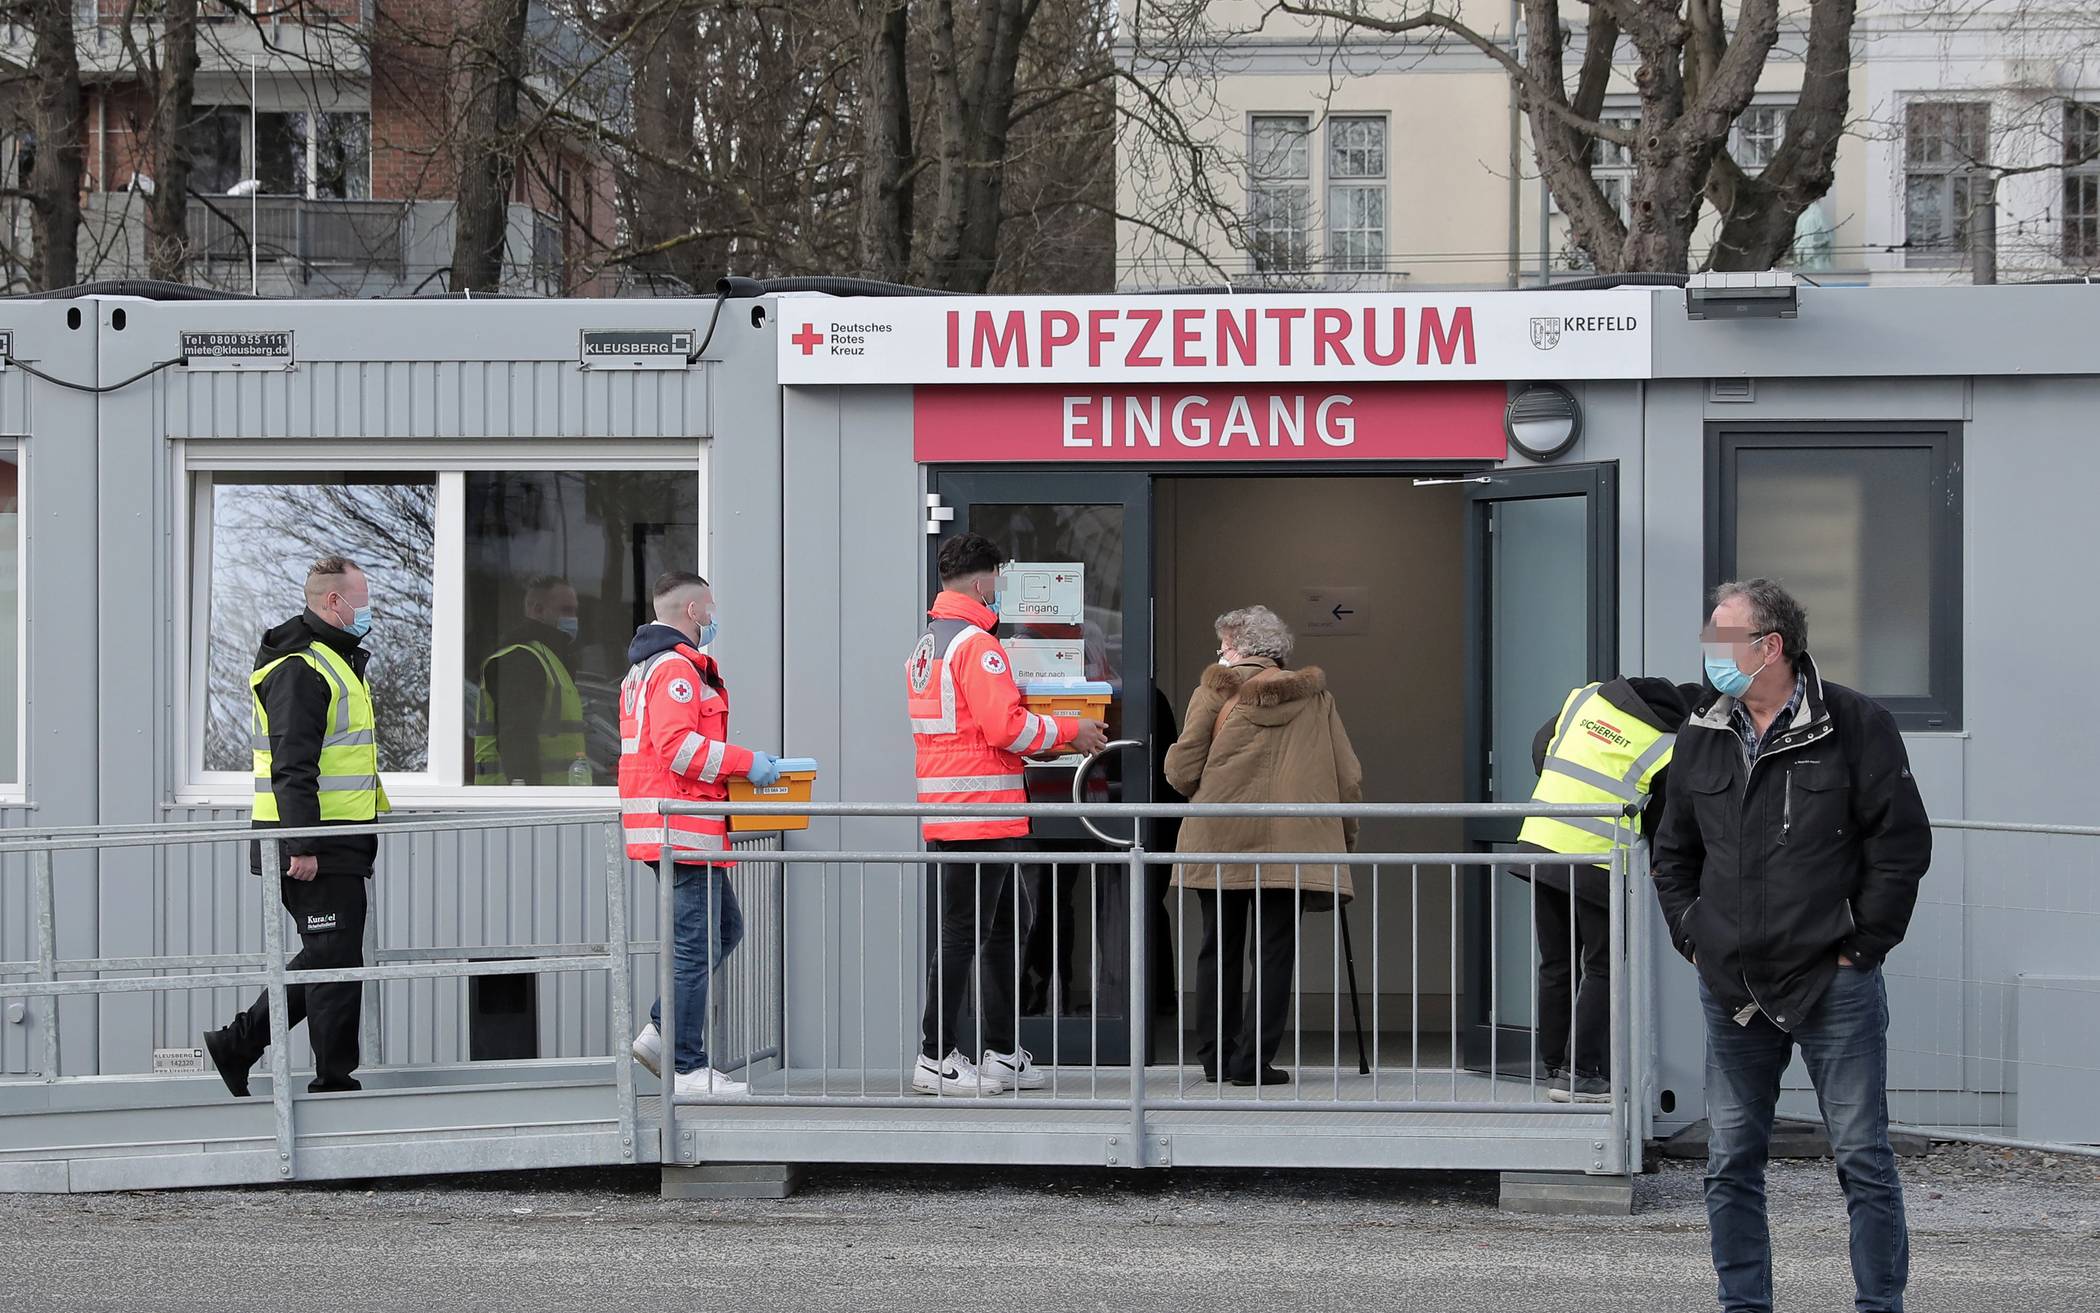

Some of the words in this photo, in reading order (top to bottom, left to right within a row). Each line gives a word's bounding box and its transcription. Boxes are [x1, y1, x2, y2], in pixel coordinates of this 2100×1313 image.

[830, 322, 893, 333] Deutsches
[1563, 316, 1638, 332] KREFELD
[184, 335, 206, 345] Tel.
[210, 335, 237, 345] 0800
[240, 335, 261, 345] 955
[264, 335, 289, 345] 1111
[830, 334, 865, 344] Rotes
[945, 306, 1478, 369] IMPFZENTRUM
[184, 345, 289, 356] miete@kleusberg.de
[586, 343, 670, 354] KLEUSBERG
[830, 345, 865, 356] Kreuz
[1062, 394, 1357, 448] EINGANG
[1018, 602, 1059, 615] Eingang
[1018, 670, 1034, 678] Bitte
[1579, 718, 1632, 748] SICHERHEIT
